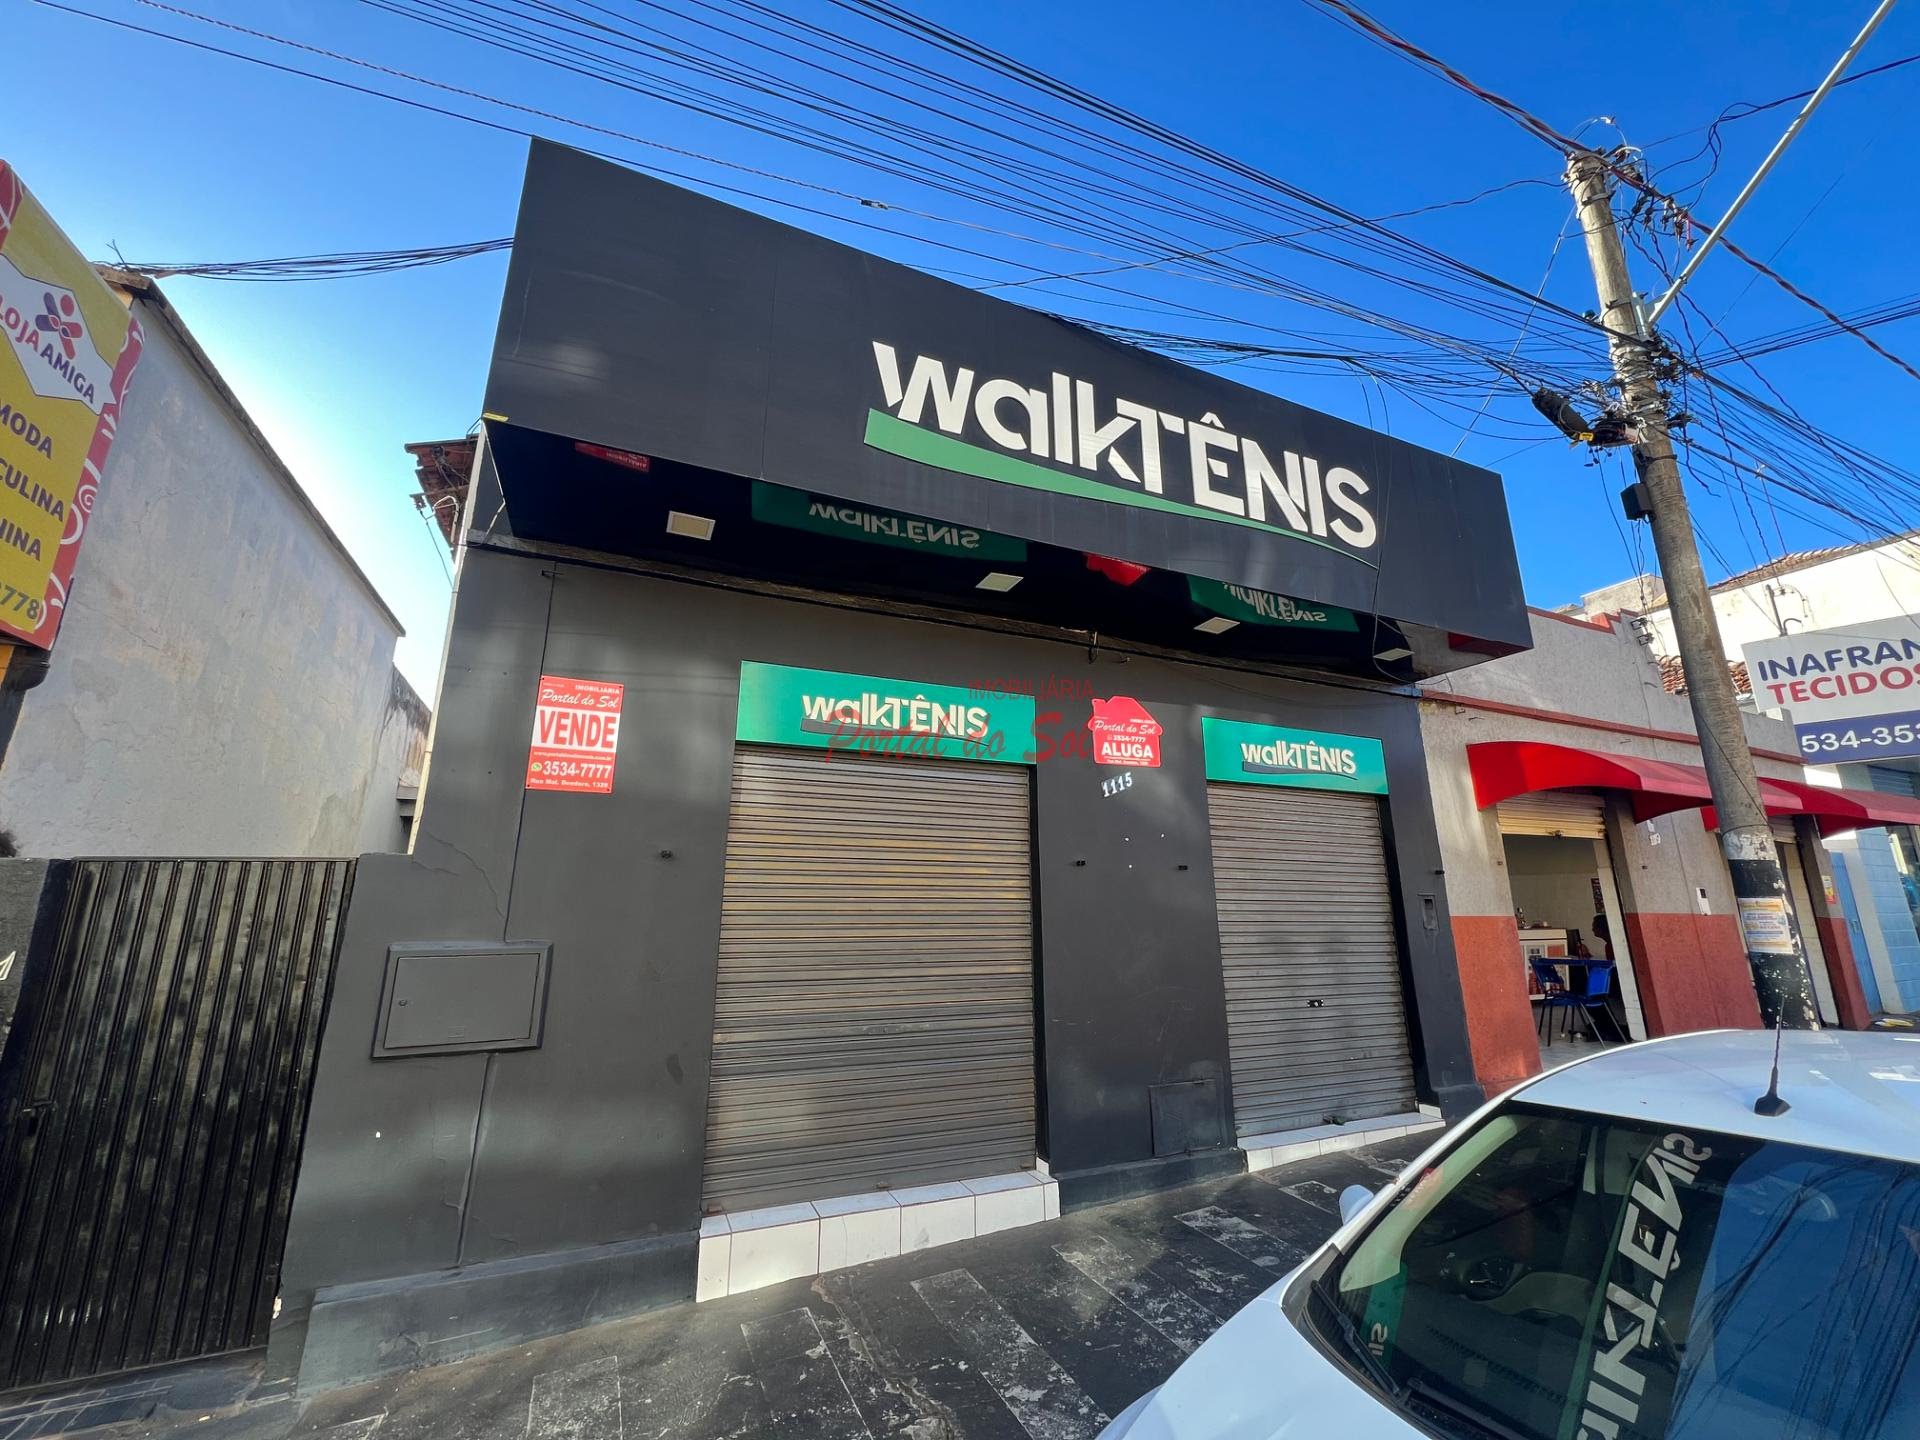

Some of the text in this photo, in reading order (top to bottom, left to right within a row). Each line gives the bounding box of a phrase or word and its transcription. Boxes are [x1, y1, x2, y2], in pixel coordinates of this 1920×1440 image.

[0, 294, 95, 404] OJA AMIGA
[872, 341, 1376, 548] walkTÊNIS
[0, 583, 39, 620] 778
[542, 690, 617, 707] Portal do Sol
[540, 710, 616, 747] VENDE
[1095, 721, 1123, 732] Portal
[1140, 725, 1155, 734] Sol
[1802, 722, 1920, 753] 534-35
[1102, 743, 1152, 758] ALUGA
[1241, 740, 1357, 775] walkTÊNIS
[543, 761, 611, 778] 3534-7777
[1102, 773, 1131, 796] 1115
